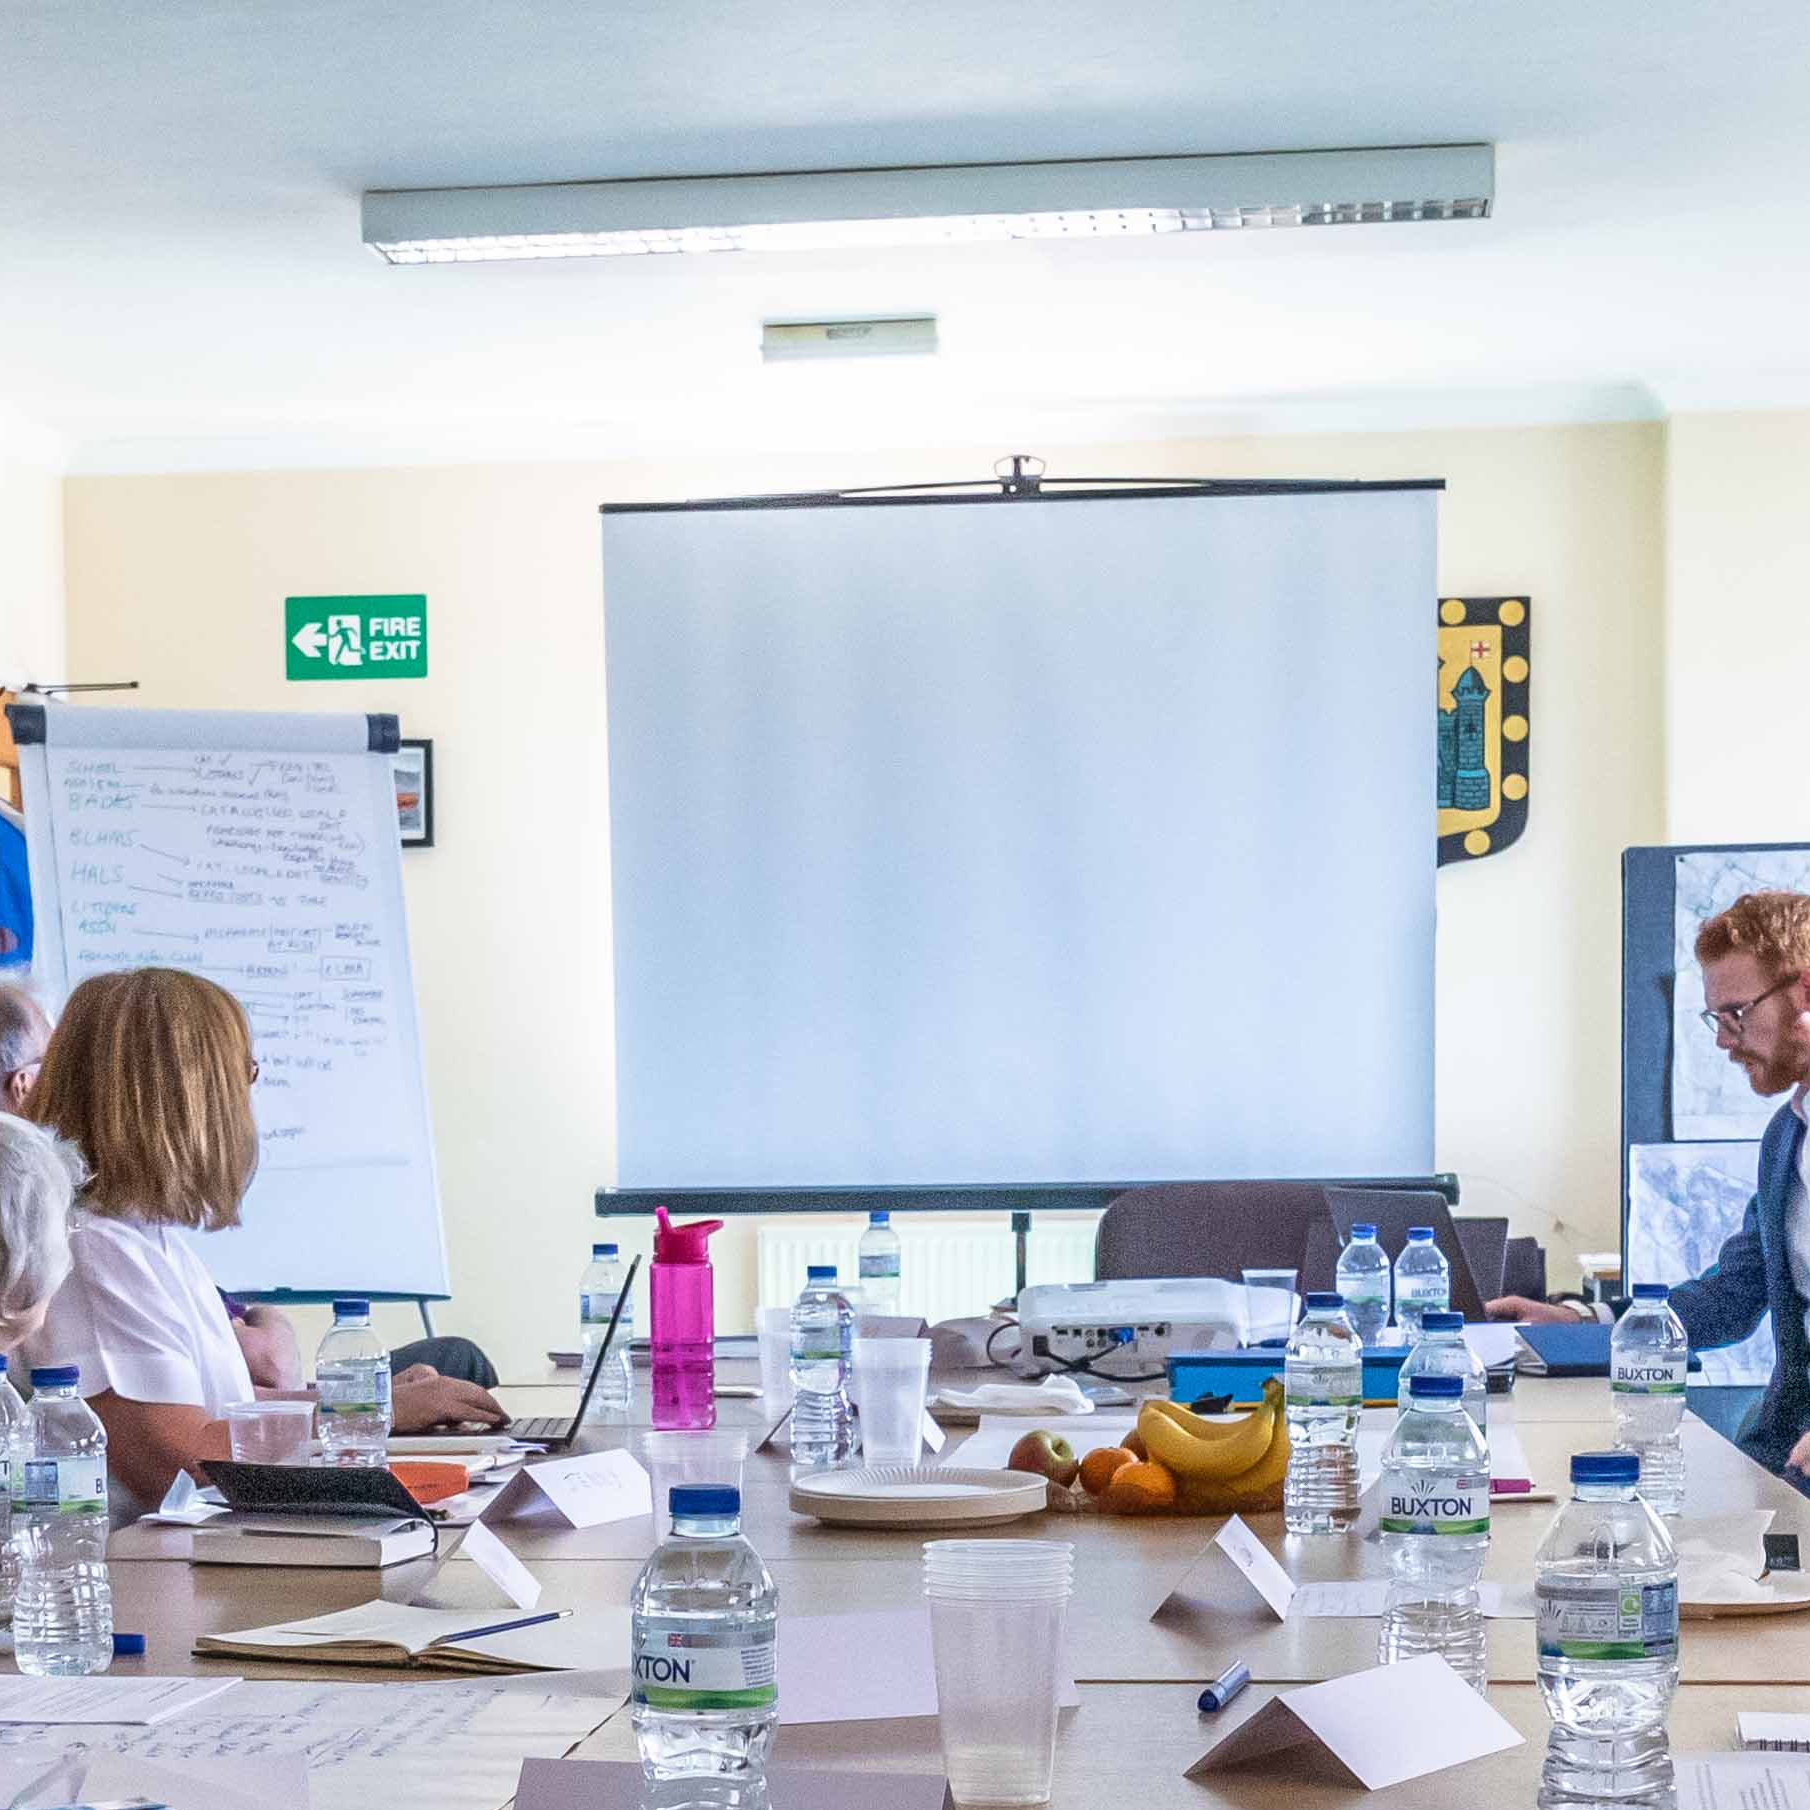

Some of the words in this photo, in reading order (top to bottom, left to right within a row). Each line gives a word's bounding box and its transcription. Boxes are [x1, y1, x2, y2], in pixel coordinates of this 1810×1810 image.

[369, 616, 422, 637] FIRE
[369, 640, 422, 661] EXIT
[1617, 1367, 1674, 1381] BUXTON
[1391, 1496, 1472, 1517] BUXTON
